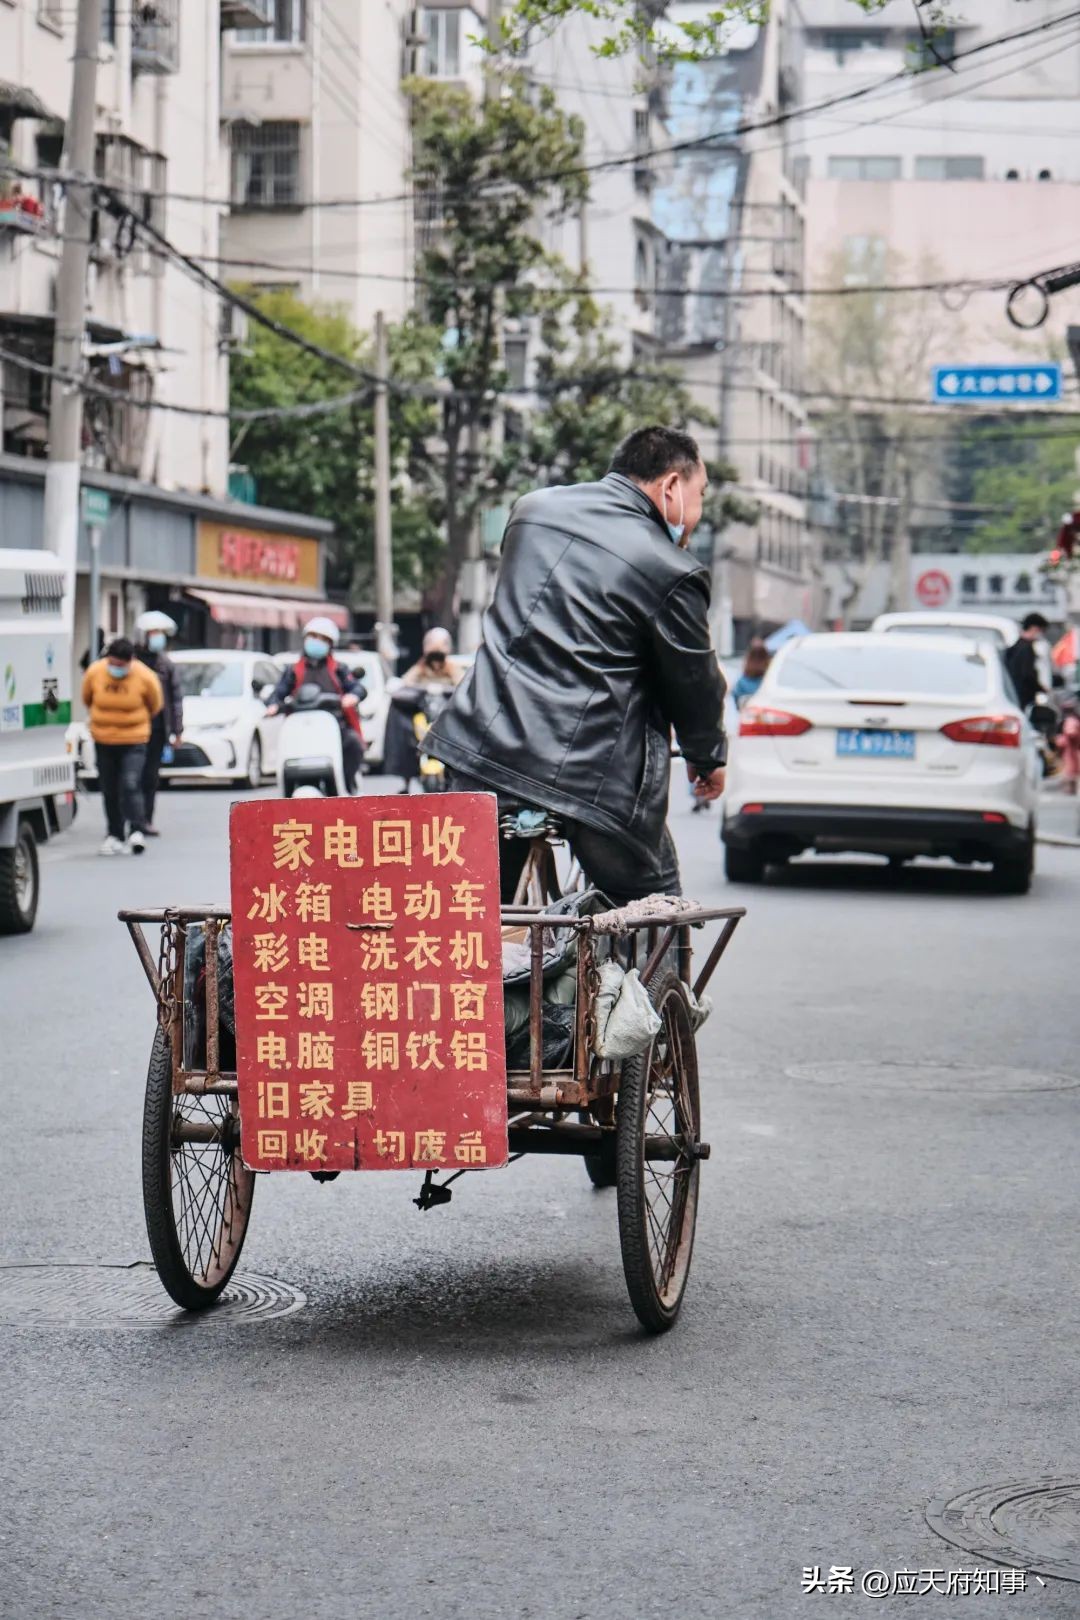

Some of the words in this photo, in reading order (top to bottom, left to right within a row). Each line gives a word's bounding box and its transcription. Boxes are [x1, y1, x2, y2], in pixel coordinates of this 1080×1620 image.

[272, 816, 467, 871] 家电回收
[247, 882, 331, 923] 冰箱
[361, 880, 486, 922] 电动车
[252, 932, 330, 972] 彩电
[360, 930, 489, 971] 洗衣机
[255, 981, 334, 1021] 空调
[361, 980, 488, 1021] 钢门窗
[256, 1031, 335, 1071] 电脑
[361, 1030, 489, 1071] 铜铁铝
[258, 1080, 373, 1121] 旧家具
[257, 1129, 487, 1163] 回收一切废品
